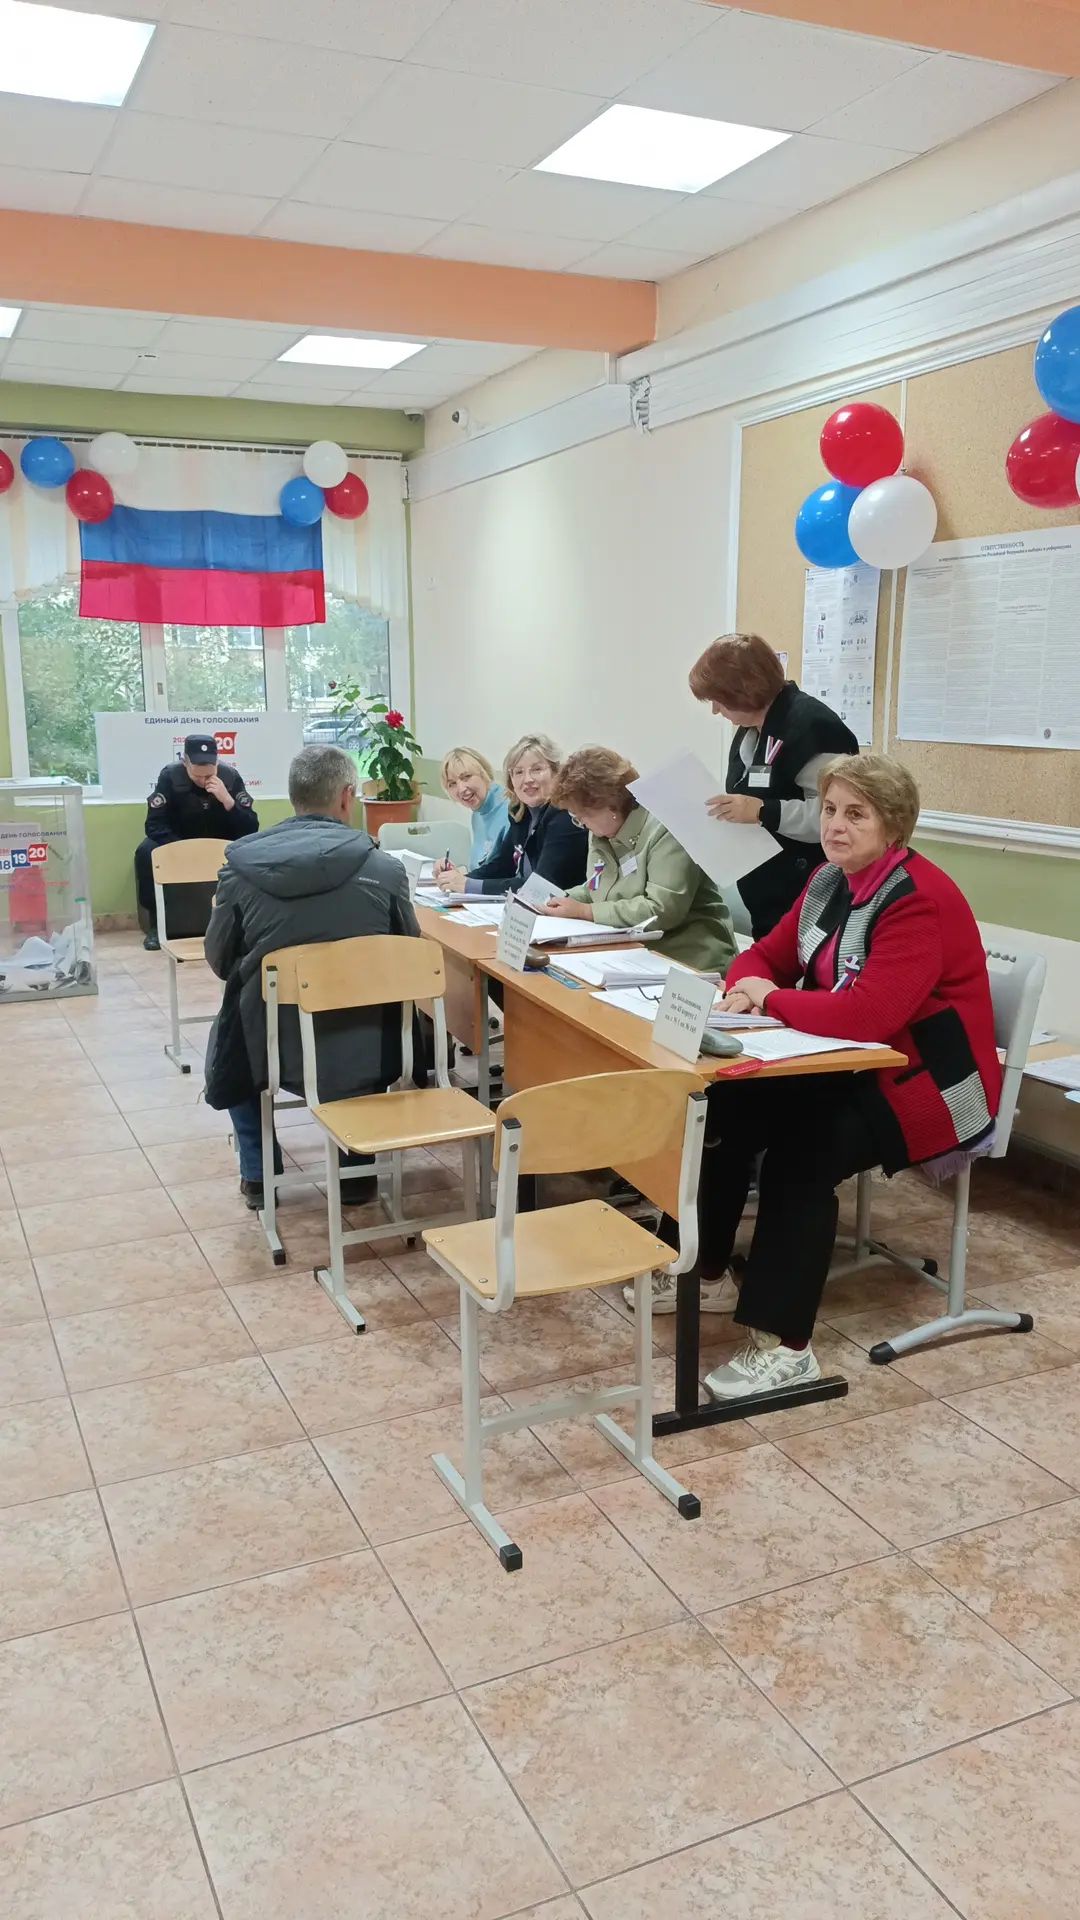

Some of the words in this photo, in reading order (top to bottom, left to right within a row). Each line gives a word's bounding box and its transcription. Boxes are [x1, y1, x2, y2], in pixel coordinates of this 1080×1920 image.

[144, 716, 179, 724] ЕДИНЫЙ
[215, 736, 234, 750] 20
[12, 853, 27, 865] 19
[28, 847, 46, 859] 20
